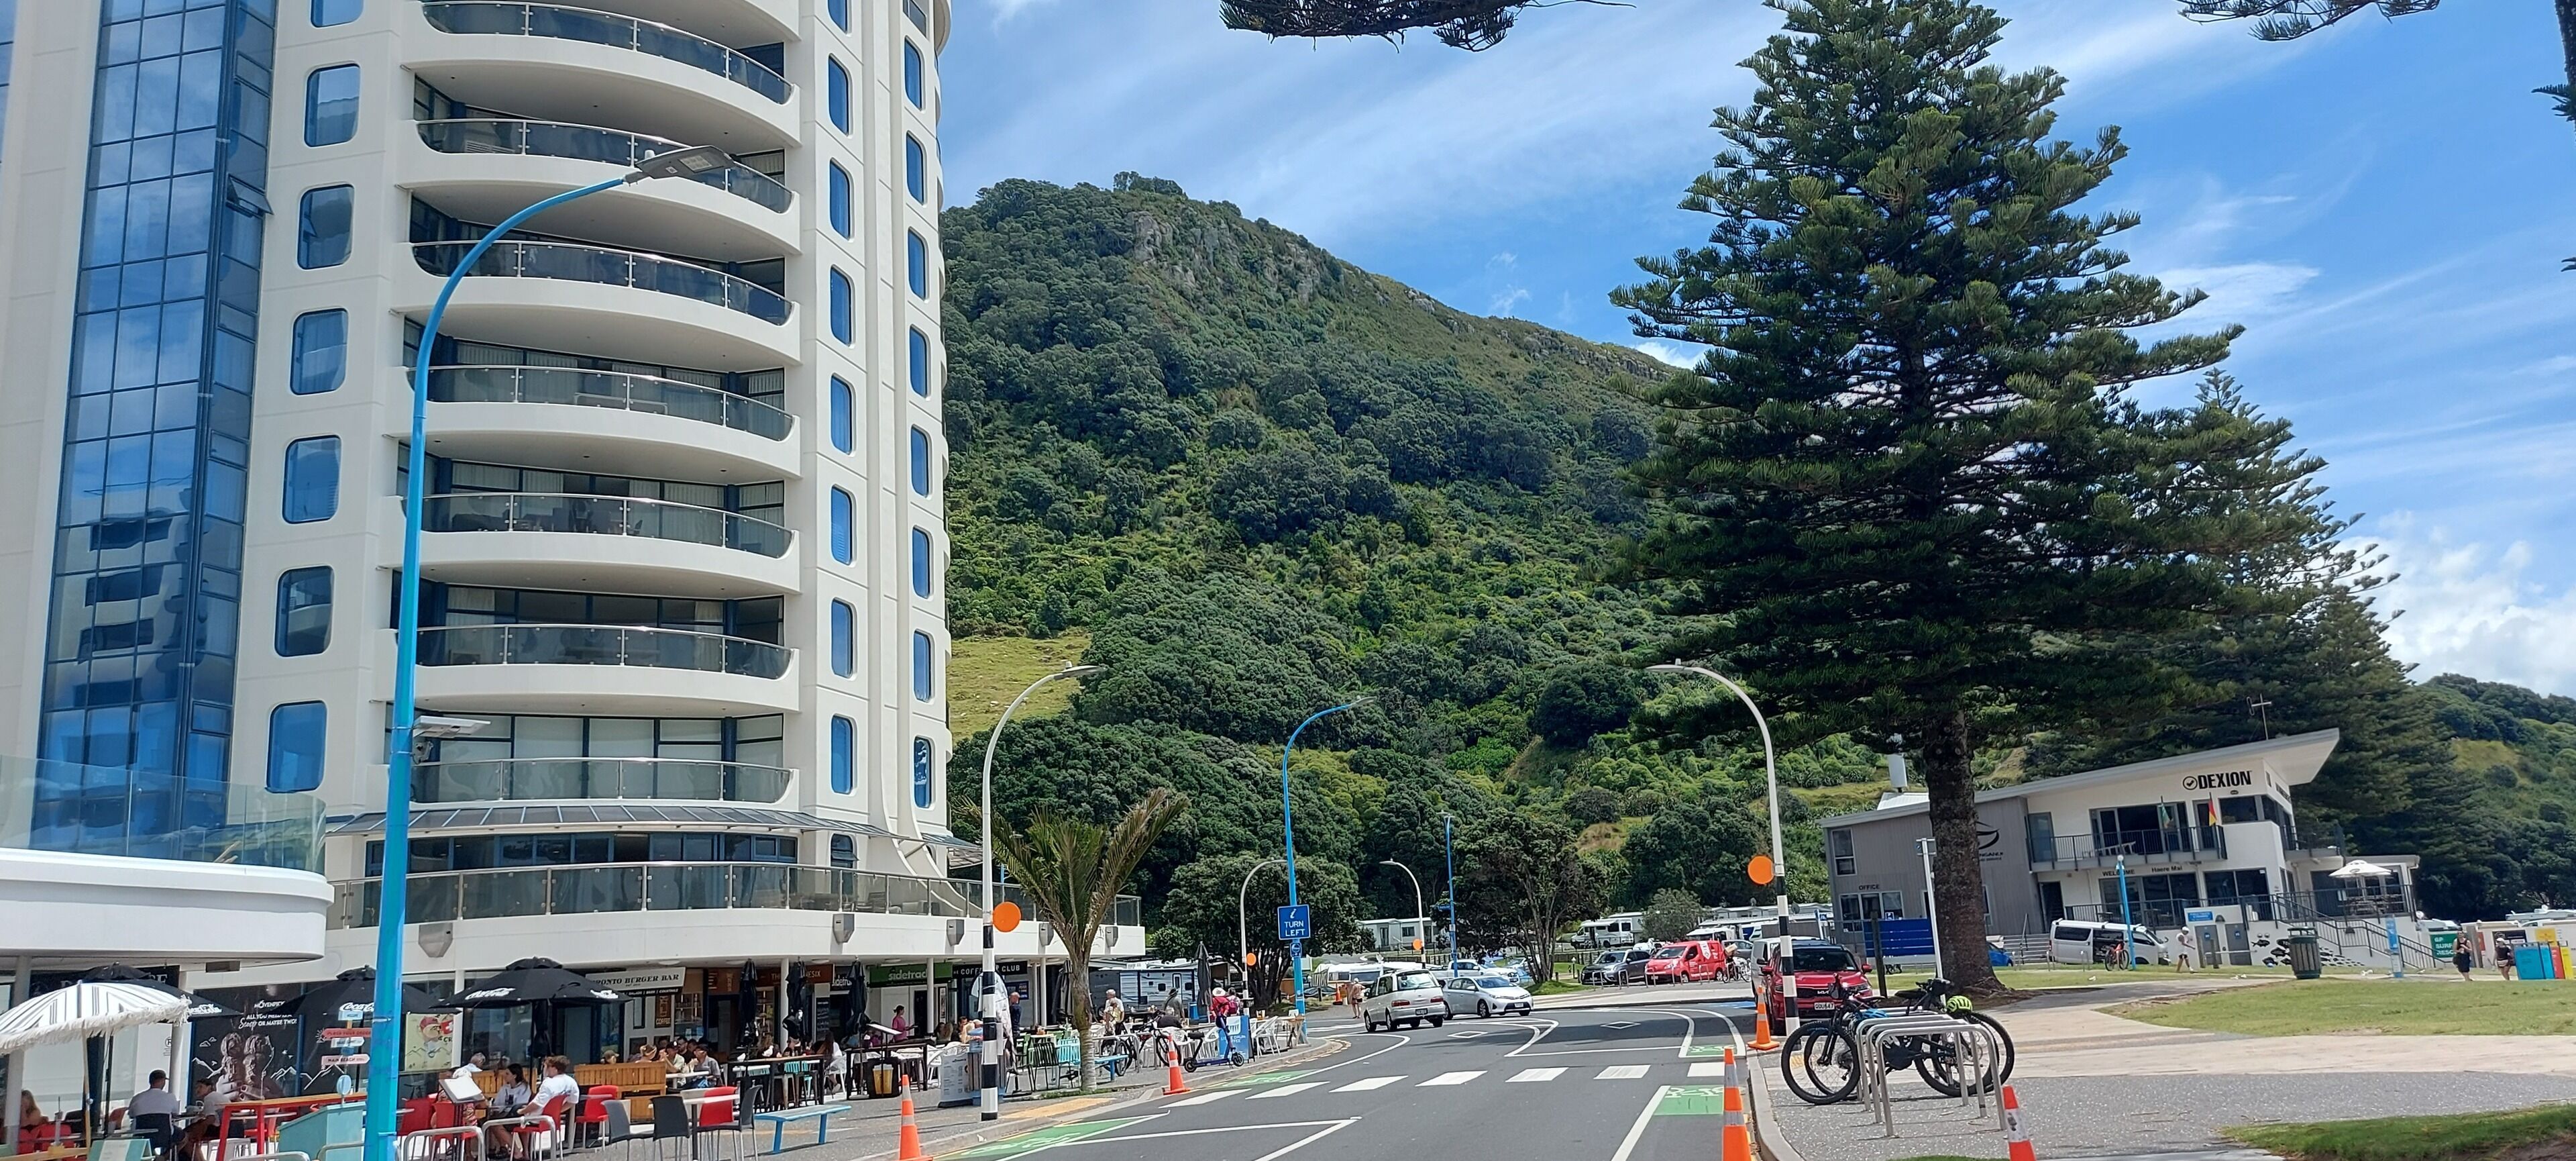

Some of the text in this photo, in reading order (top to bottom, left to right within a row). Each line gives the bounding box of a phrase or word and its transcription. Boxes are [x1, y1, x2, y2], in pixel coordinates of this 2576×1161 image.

[2198, 771, 2251, 789] DEXION
[1284, 920, 1304, 928] TURN
[1285, 929, 1305, 937] LEFT
[1002, 964, 1020, 972] CLUB
[888, 969, 928, 980] sidetrac
[625, 975, 658, 984] BURGER
